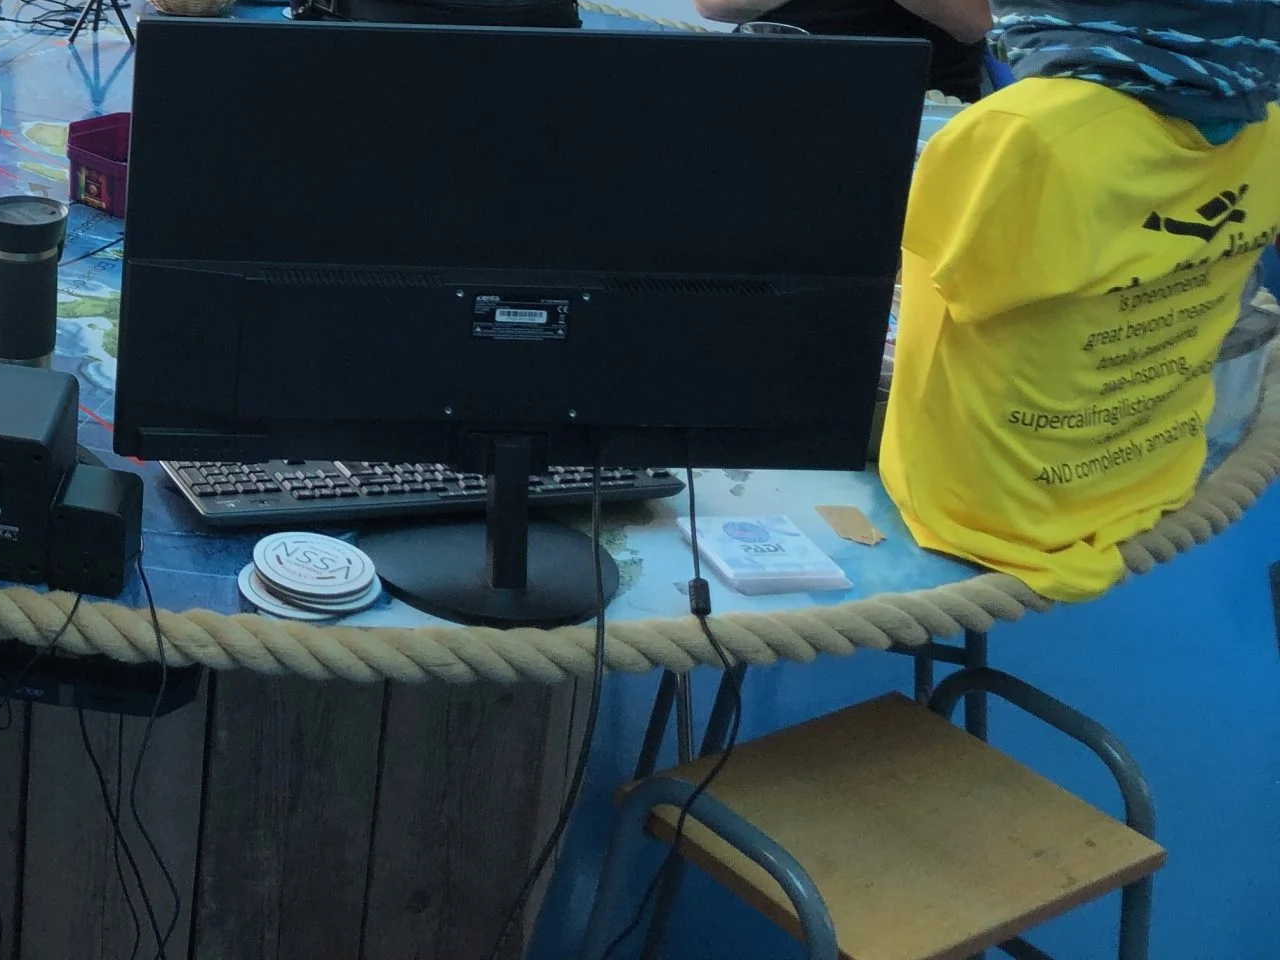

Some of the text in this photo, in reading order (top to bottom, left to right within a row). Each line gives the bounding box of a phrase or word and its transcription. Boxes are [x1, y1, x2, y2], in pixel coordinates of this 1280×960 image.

[1083, 324, 1124, 352] great
[1125, 307, 1175, 340] beyond
[1033, 462, 1073, 485] AND
[1074, 439, 1144, 477] completely
[271, 540, 352, 581] NSSA
[740, 543, 787, 554] PADI
